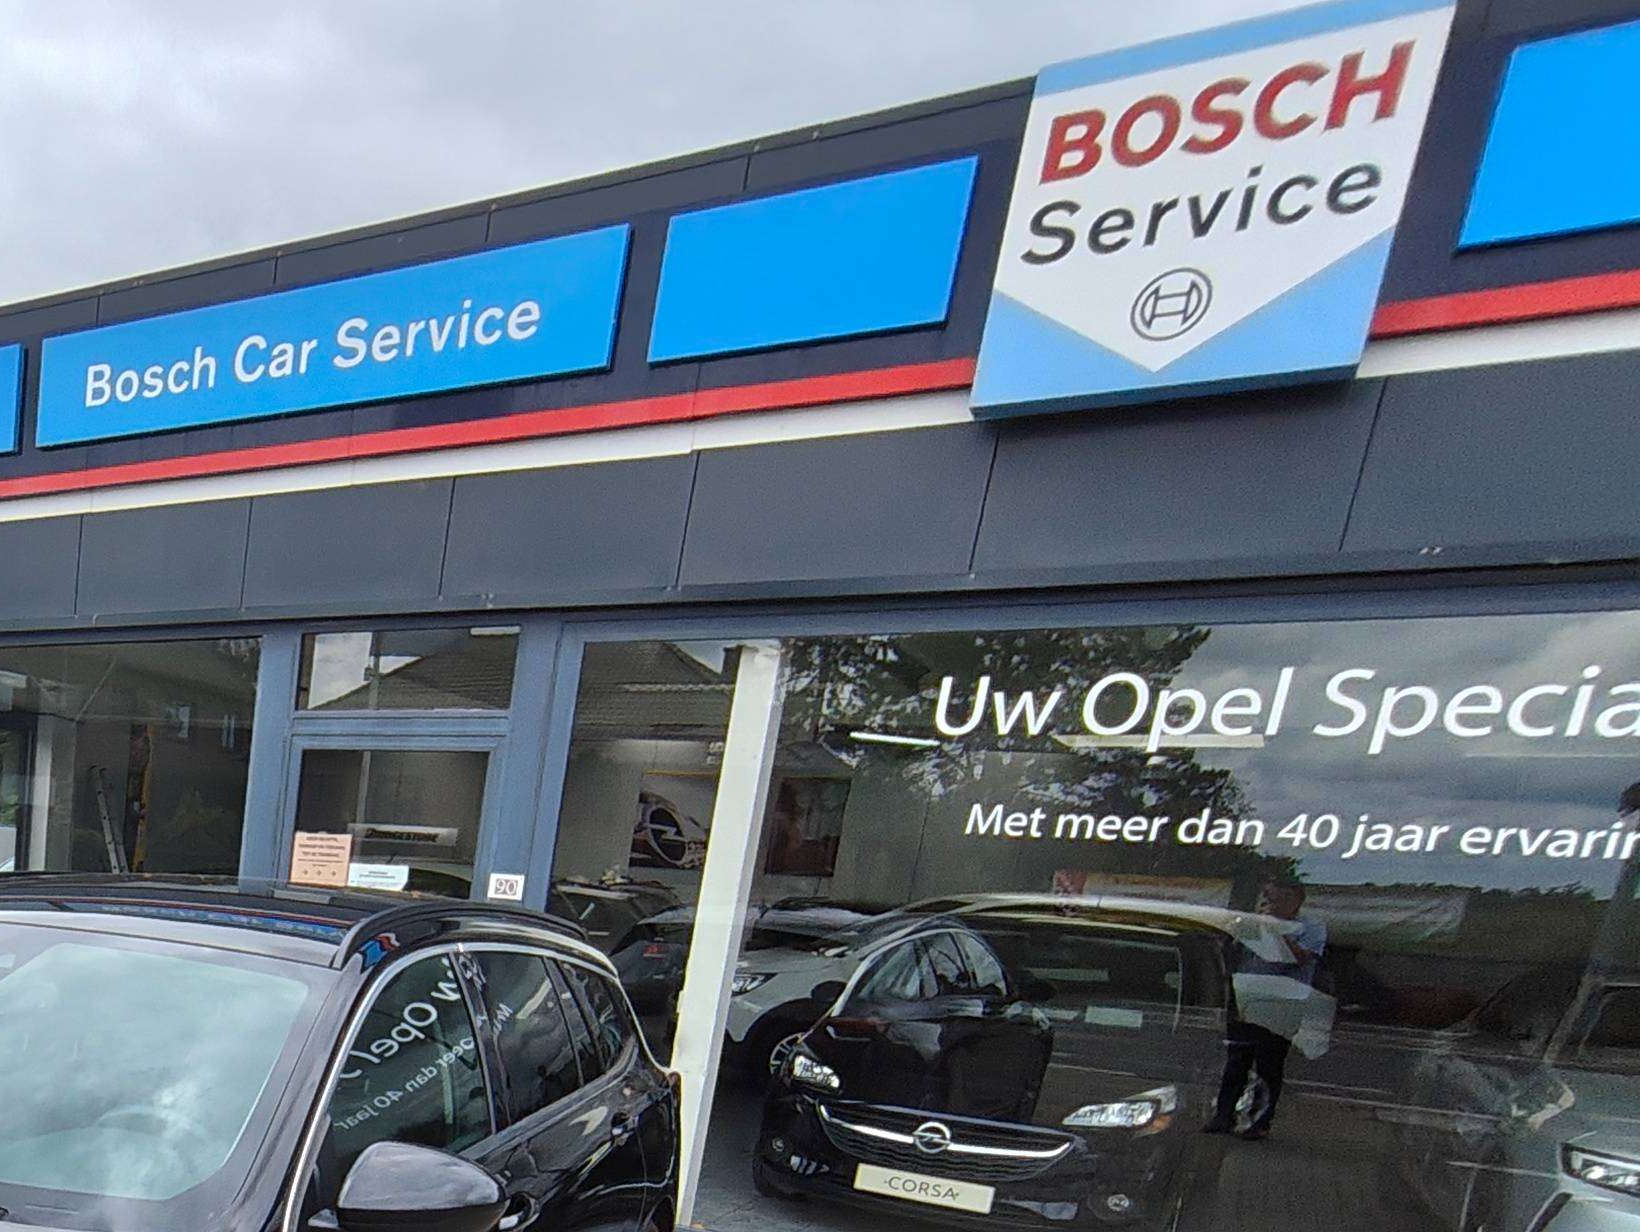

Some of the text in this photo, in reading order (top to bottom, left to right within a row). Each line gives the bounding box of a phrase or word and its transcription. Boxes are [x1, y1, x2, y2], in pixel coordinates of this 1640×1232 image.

[1040, 41, 1417, 185] BOSCH
[1021, 160, 1381, 266] Service
[85, 299, 541, 408] Bosch Car Service
[934, 665, 1640, 754] Uw Opel Specia
[964, 803, 1046, 838] Met
[1054, 812, 1170, 842] meer
[1177, 809, 1264, 846] dan
[1276, 813, 1340, 848] 40
[1341, 813, 1450, 859] jaar
[495, 878, 518, 896] 90
[887, 1176, 958, 1200] CORSA
